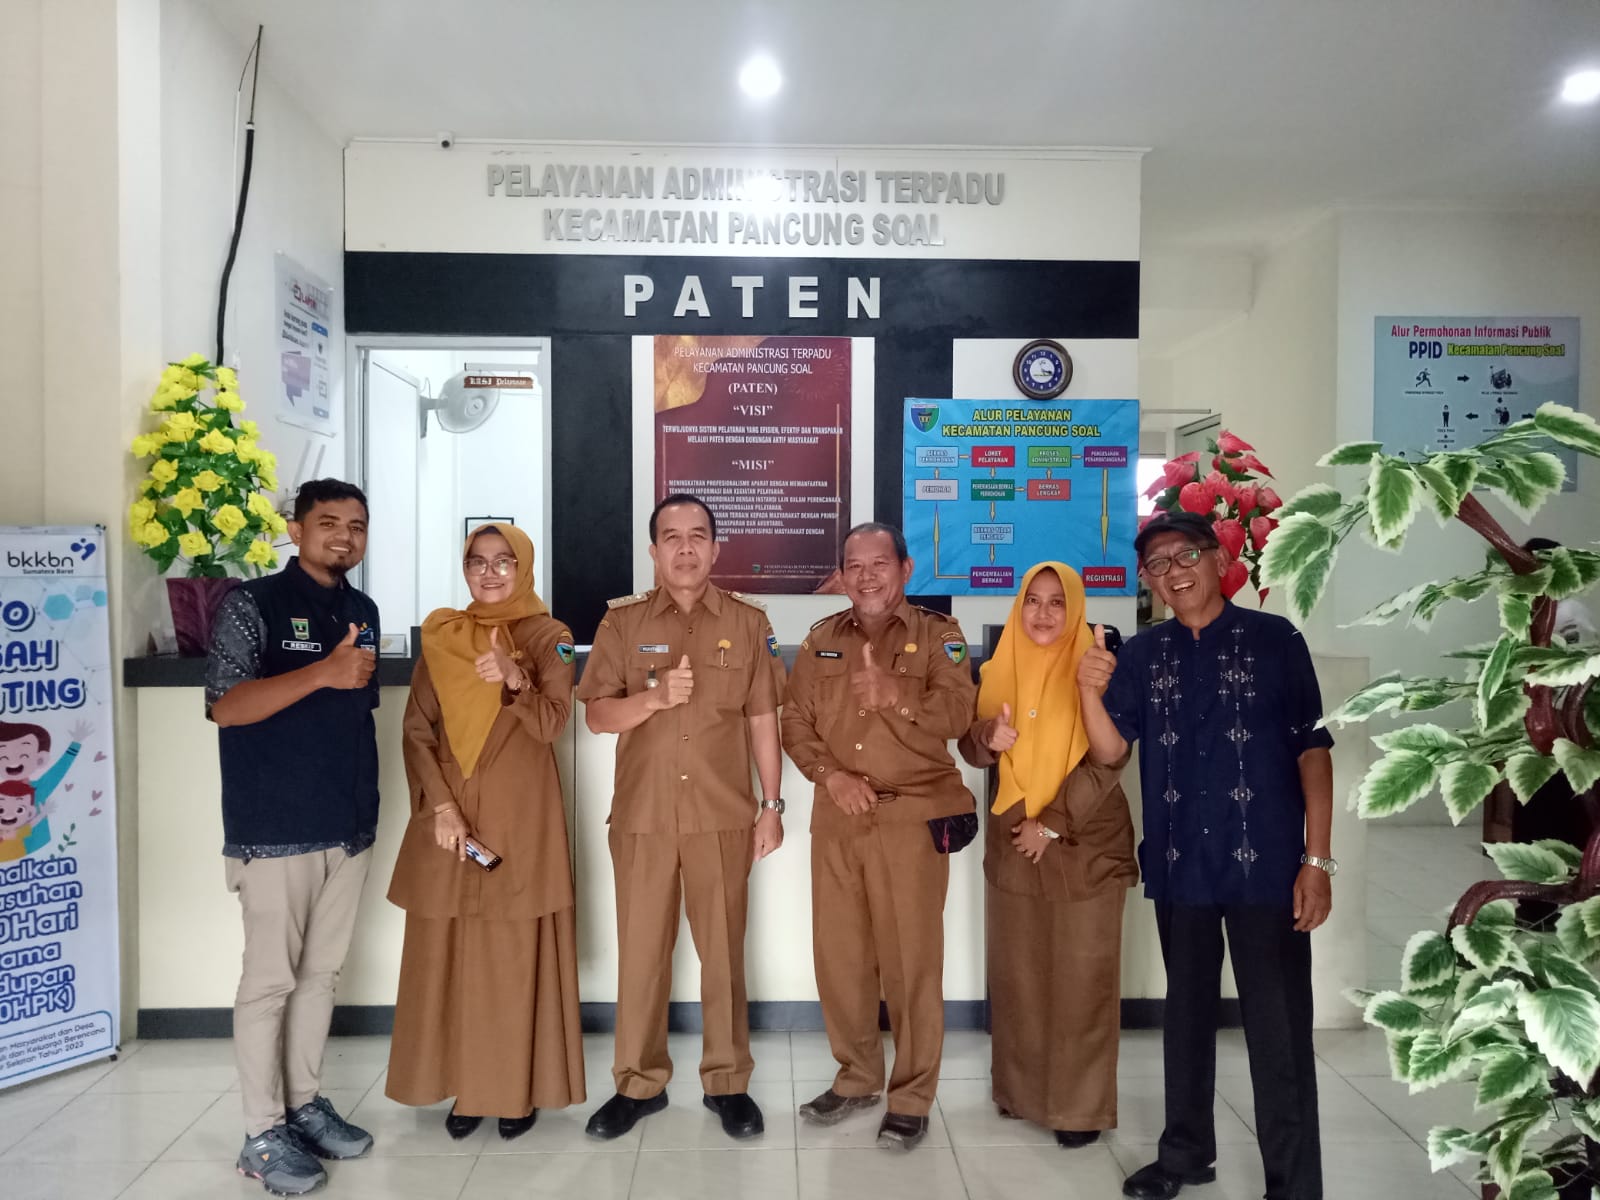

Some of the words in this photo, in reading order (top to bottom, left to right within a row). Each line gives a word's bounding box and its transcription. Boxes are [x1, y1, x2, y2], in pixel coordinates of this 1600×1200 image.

[487, 164, 654, 199] PELAYANAN
[662, 167, 867, 203] ADMINSTRASI
[875, 171, 1005, 205] TERPADU
[543, 208, 718, 243] KECAMATAN
[728, 211, 864, 246] PANCUNG
[872, 213, 945, 246] SOAL
[624, 275, 881, 319] PATEN
[1391, 325, 1410, 337] Alur
[1413, 325, 1471, 338] Permohonan
[1474, 326, 1519, 338] Informasi
[1522, 326, 1551, 338] Publik
[674, 347, 723, 358] PELAYANAN
[726, 348, 789, 359] ADMINISTRASI
[793, 348, 832, 359] TERPADU
[1409, 341, 1442, 359] PPID
[1448, 343, 1500, 356] Kecamatan
[1500, 344, 1543, 357] Pancung
[693, 363, 744, 373] KECAMATAN
[747, 363, 788, 374] PANCUNG
[791, 364, 813, 374] SOAL
[728, 382, 778, 395] (PATEN)
[972, 410, 1002, 421] ALUR
[1006, 410, 1071, 422] PELAYANAN
[942, 425, 1011, 437] KECAMATAN
[1014, 426, 1068, 437] PANCUNG
[1072, 426, 1100, 437] SOAL
[7, 551, 74, 567] bkkbn
[65, 1040, 84, 1052] 2023
